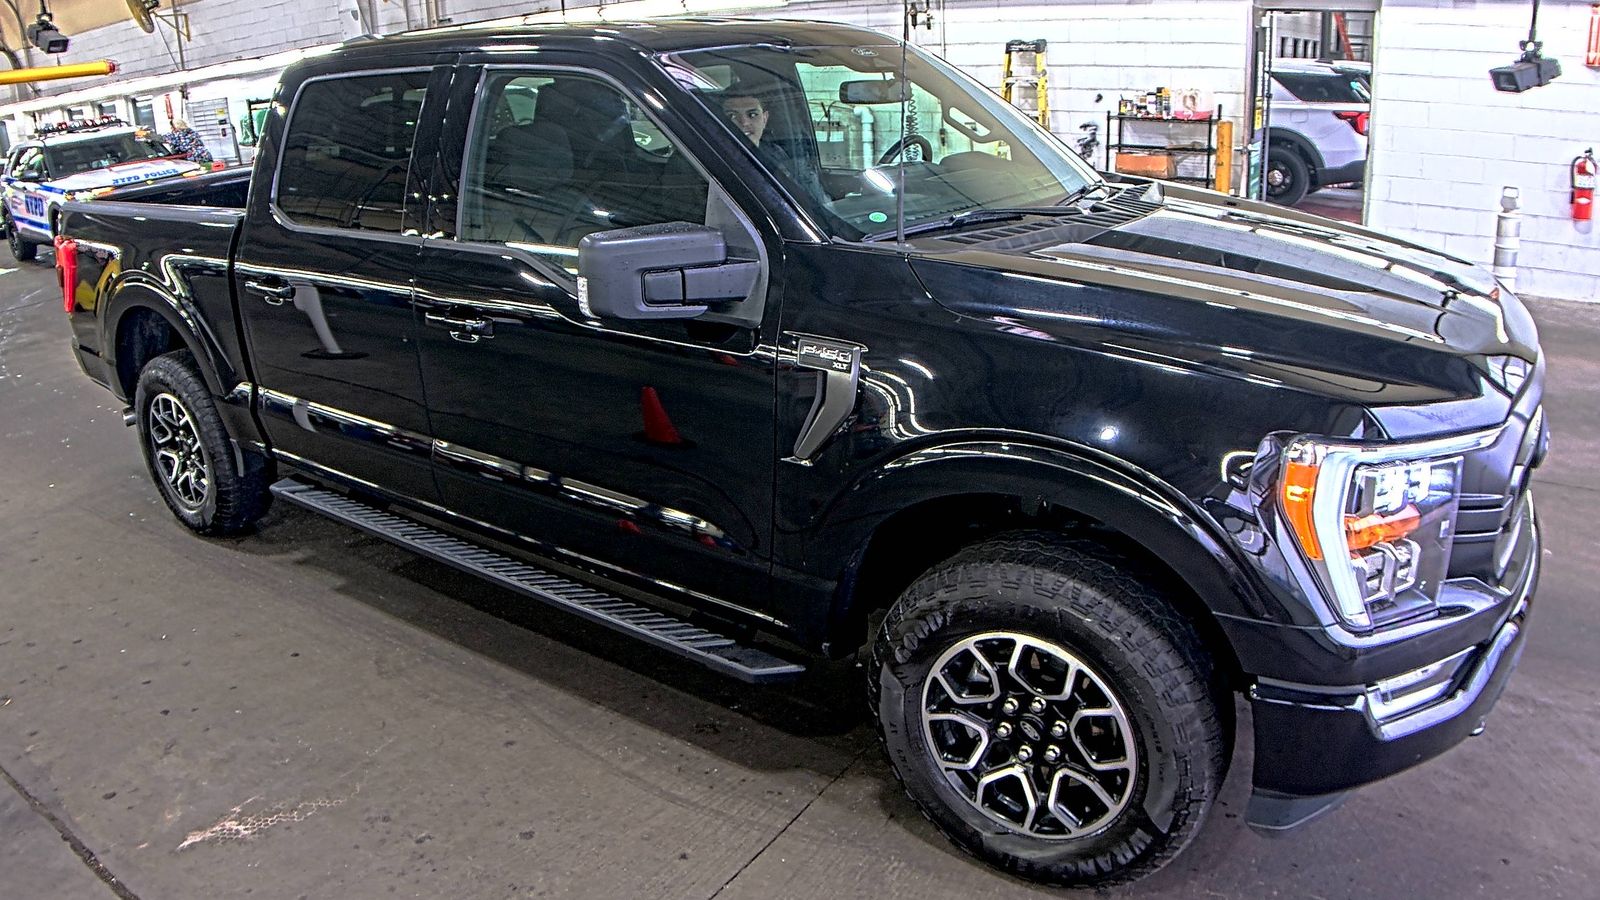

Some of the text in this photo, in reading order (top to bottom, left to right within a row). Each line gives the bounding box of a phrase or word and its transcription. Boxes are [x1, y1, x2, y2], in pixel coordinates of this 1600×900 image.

[112, 168, 179, 185] NYPD POLICE
[25, 194, 44, 217] NYPD
[832, 361, 848, 370] XLT
